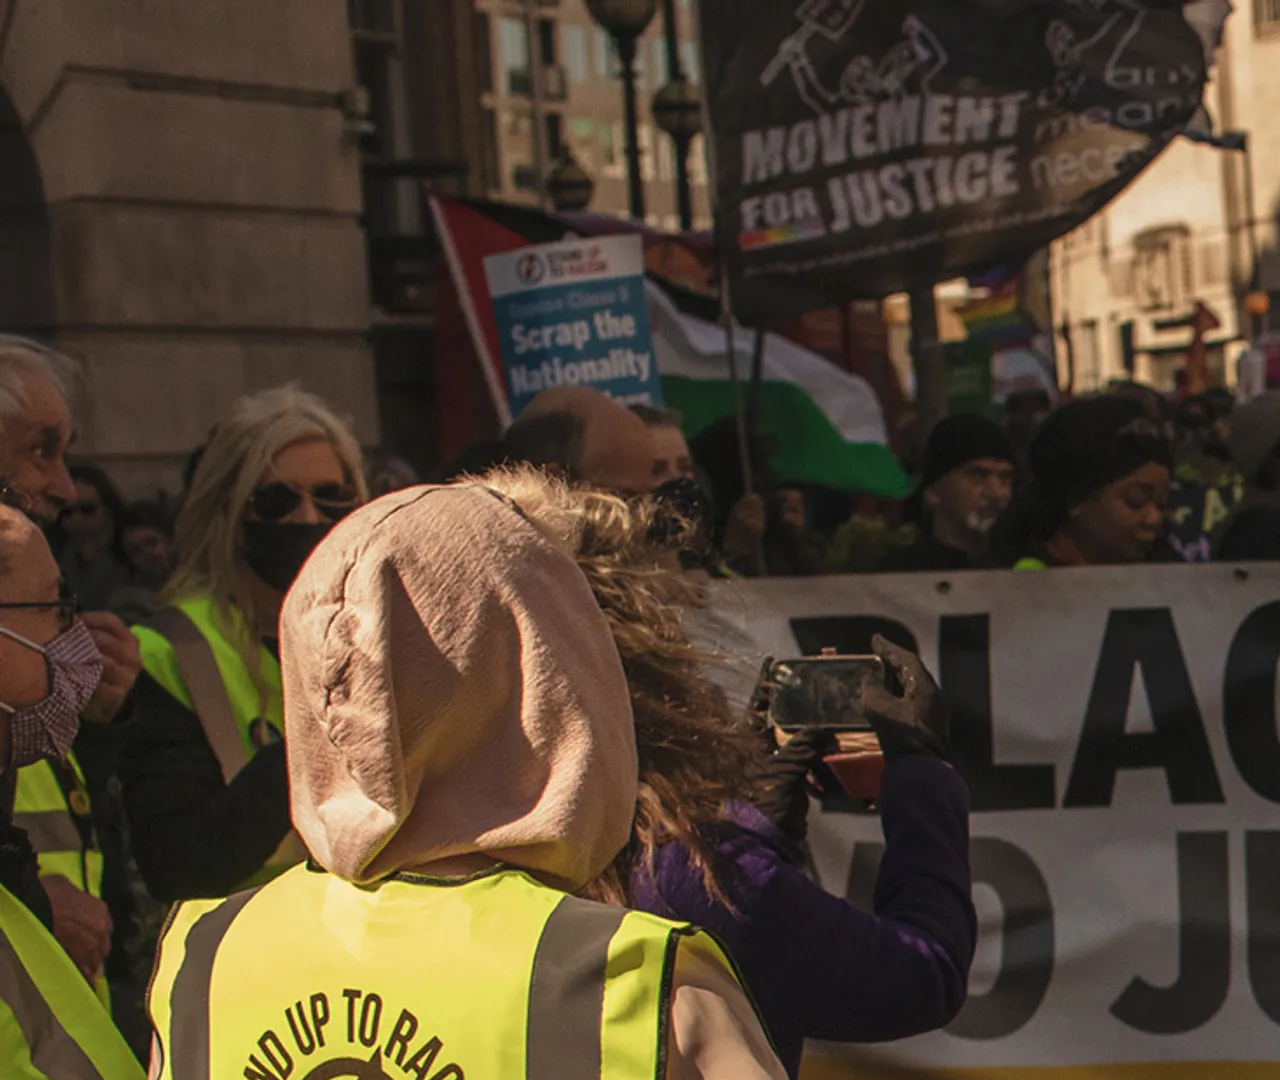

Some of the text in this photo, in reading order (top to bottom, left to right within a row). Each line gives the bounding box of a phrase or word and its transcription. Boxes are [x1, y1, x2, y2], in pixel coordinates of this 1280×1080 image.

[741, 90, 1032, 186] MOVEMENT
[740, 145, 1020, 233] FOR JUSTICE
[511, 308, 636, 354] Scrap the
[510, 348, 650, 396] Nationality
[846, 836, 1055, 1042] O
[284, 992, 330, 1056] UP
[342, 988, 383, 1047] TO
